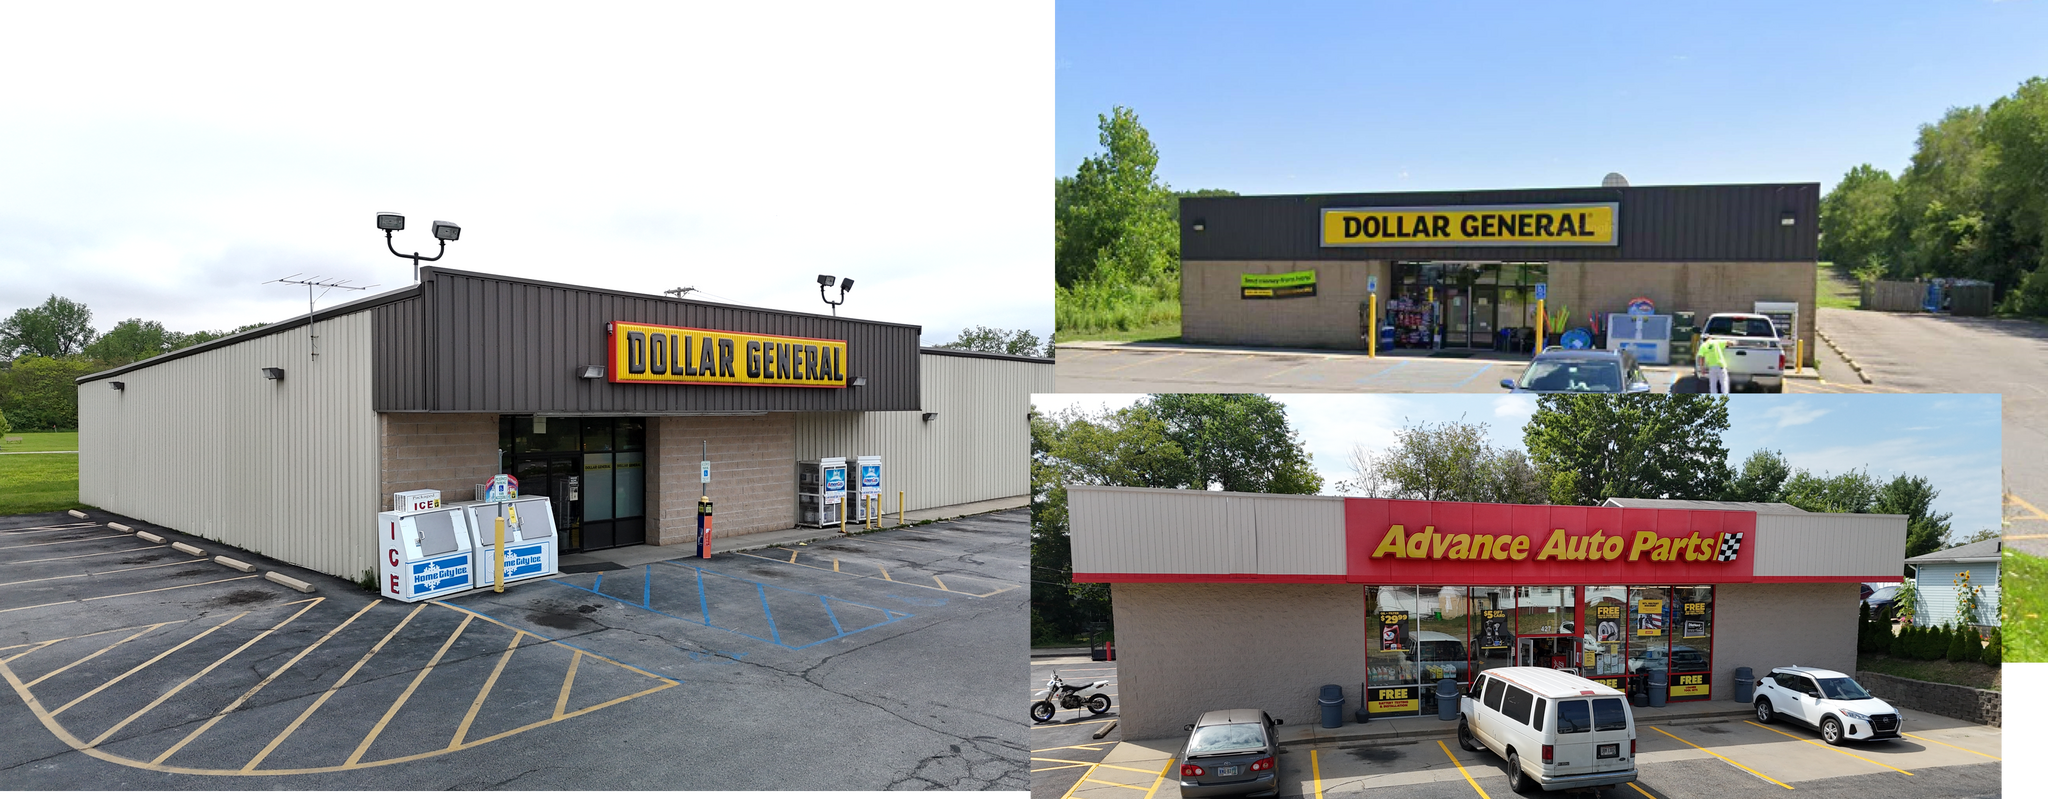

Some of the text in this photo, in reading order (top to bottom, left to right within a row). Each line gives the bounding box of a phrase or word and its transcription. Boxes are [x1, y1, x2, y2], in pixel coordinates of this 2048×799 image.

[1343, 213, 1594, 239] DOLLAR GENERAL
[627, 331, 844, 382] DOLLAR GENERAL
[414, 500, 434, 511] ICE
[1370, 524, 1715, 561] Advance Auto Parts
[389, 521, 400, 595] ICE
[516, 557, 530, 565] City
[414, 567, 467, 583] Home City Ice
[1597, 606, 1620, 615] FREE
[1684, 603, 1706, 611] FREE
[1680, 675, 1703, 684] FREE
[1379, 688, 1408, 699] FREE
